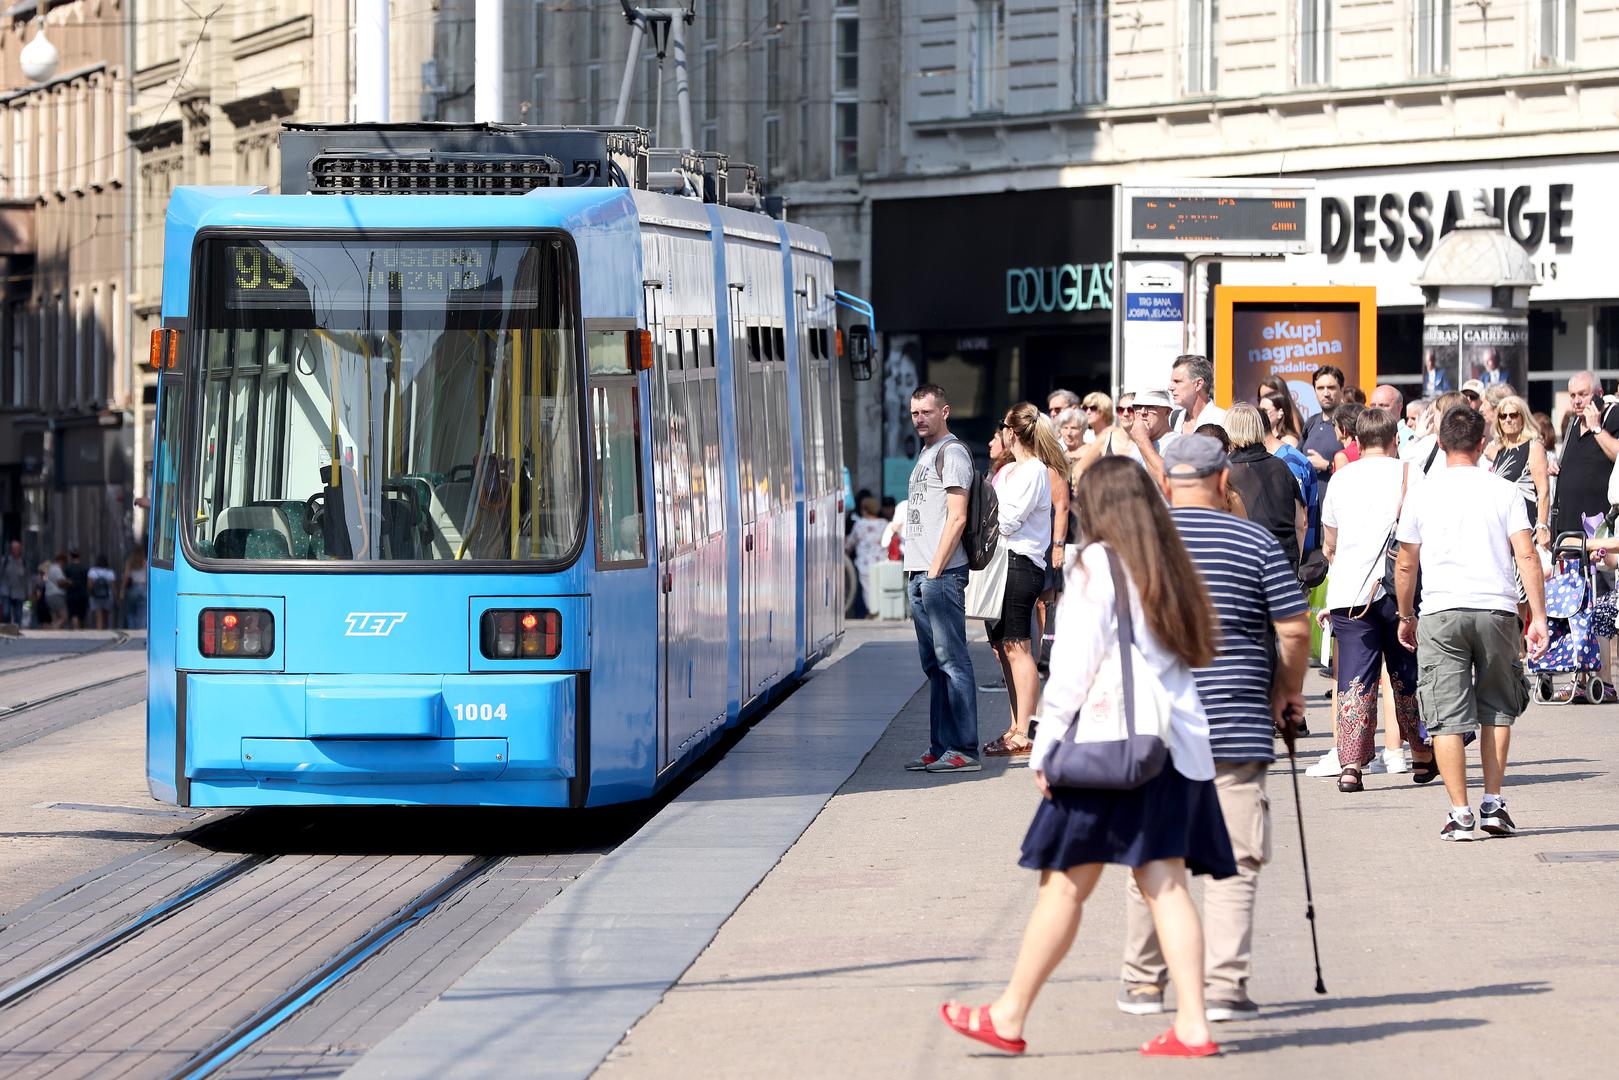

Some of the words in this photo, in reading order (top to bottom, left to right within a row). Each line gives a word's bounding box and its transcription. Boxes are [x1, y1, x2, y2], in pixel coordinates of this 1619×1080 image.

[236, 247, 293, 289] 99
[1139, 296, 1152, 306] TRG
[1153, 296, 1171, 306] BANA
[1263, 319, 1322, 342] eKupi
[1248, 338, 1342, 364] nagradna
[1270, 361, 1319, 375] padalica
[344, 612, 408, 636] ZET
[453, 703, 508, 721] 1004
